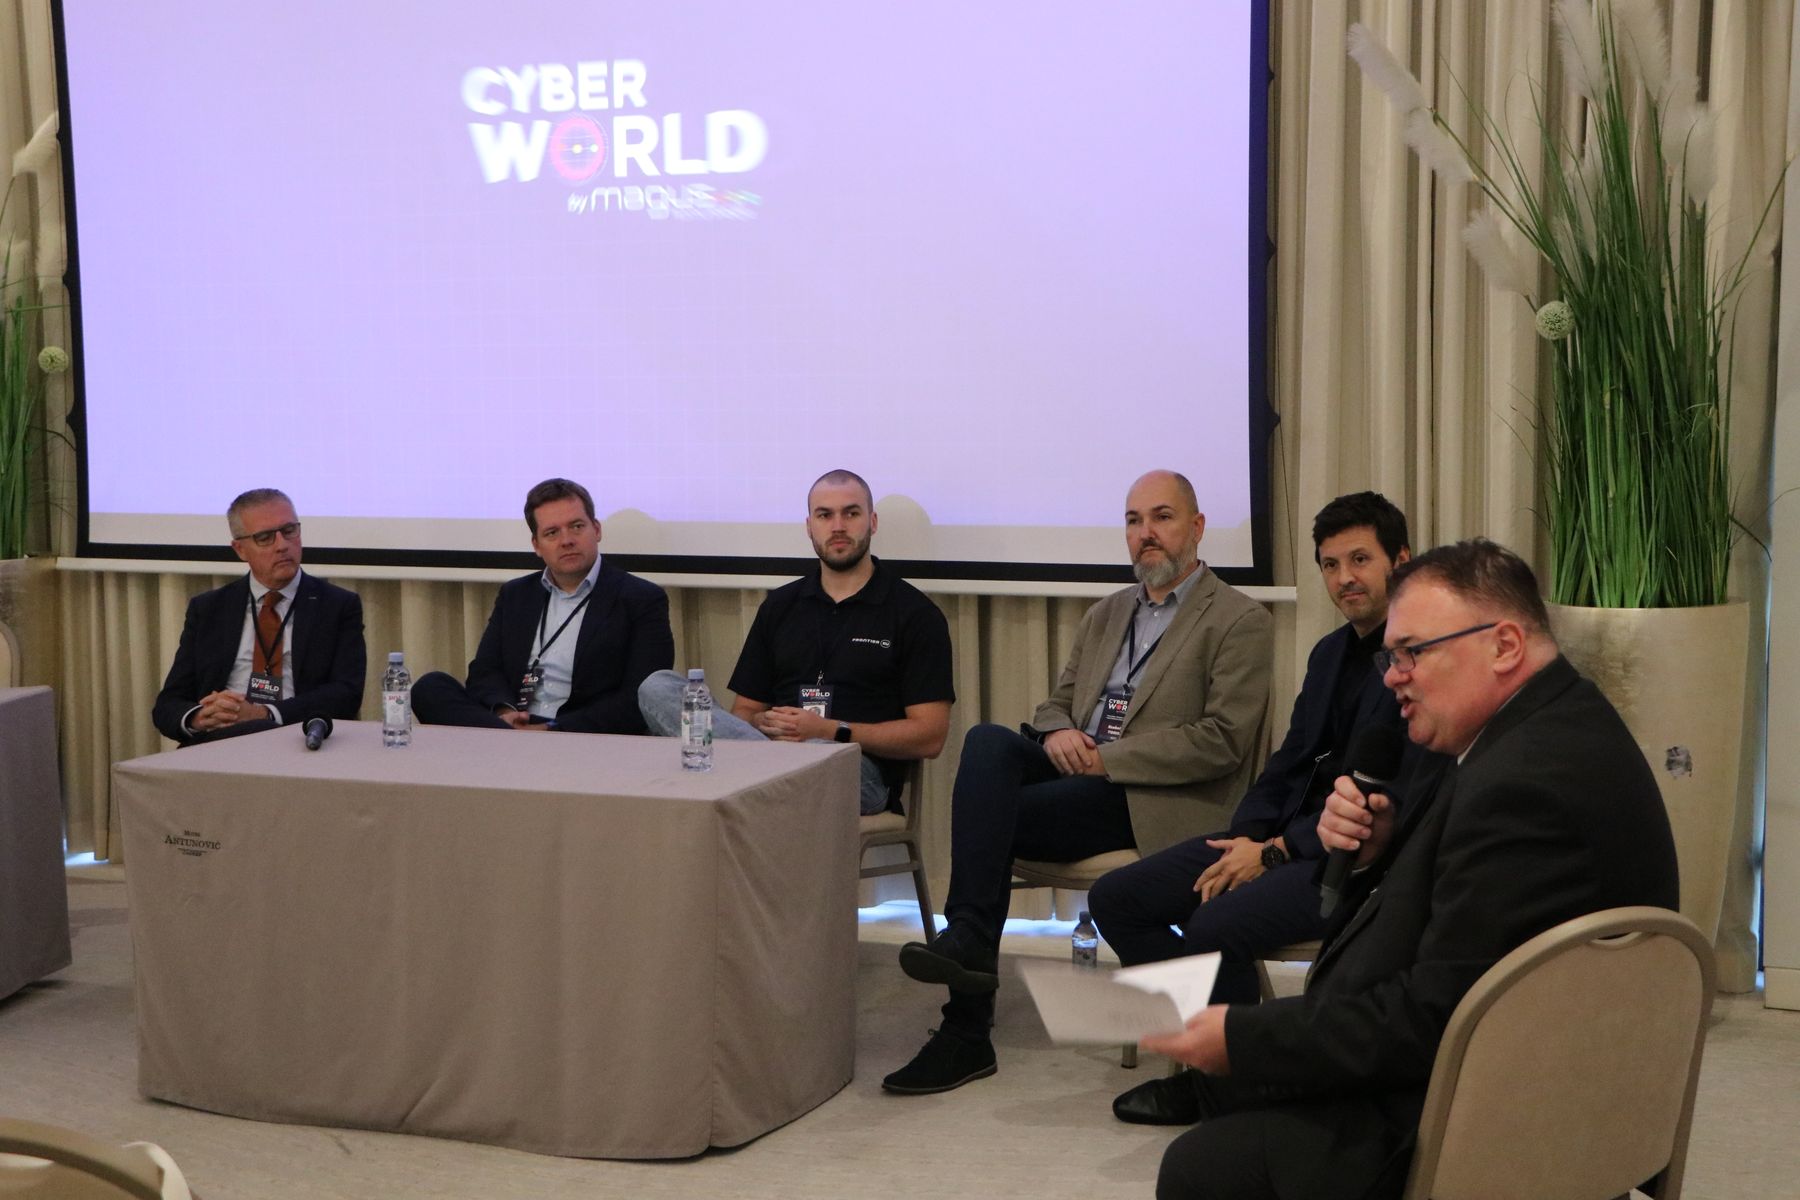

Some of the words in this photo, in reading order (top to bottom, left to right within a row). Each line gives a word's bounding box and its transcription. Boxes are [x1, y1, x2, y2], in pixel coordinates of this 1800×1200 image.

[460, 58, 647, 116] CYBER
[467, 109, 768, 184] WORLD
[251, 682, 280, 692] WORLD
[1108, 703, 1128, 711] WOR
